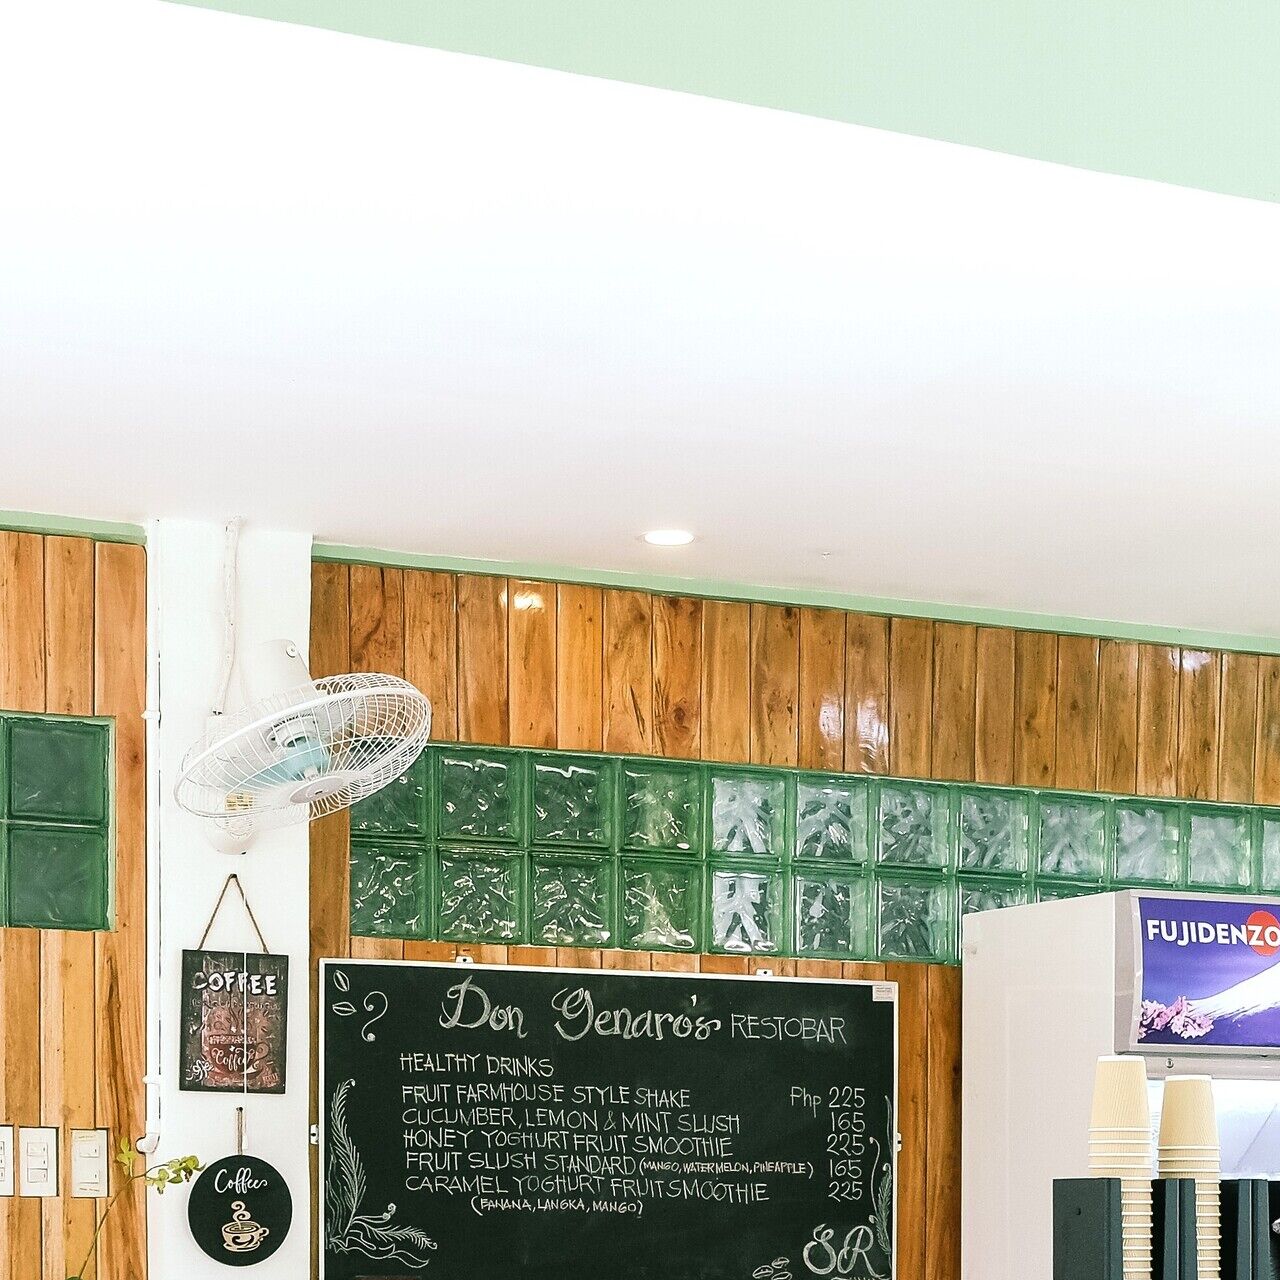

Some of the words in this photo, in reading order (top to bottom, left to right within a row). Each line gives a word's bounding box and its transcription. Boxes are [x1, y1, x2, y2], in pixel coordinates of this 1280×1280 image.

[192, 971, 277, 995] COFFEE
[438, 974, 529, 1039] Don
[730, 1012, 847, 1045] RESTOBAR
[399, 1052, 481, 1074] HEALTHY
[486, 1053, 555, 1078] DRINKS
[402, 1084, 451, 1104] FRUIT
[456, 1082, 564, 1104] FARMHOUSE
[571, 1085, 631, 1106] STYLE
[633, 1087, 691, 1109] SHAKE
[789, 1086, 822, 1118] Php
[828, 1086, 866, 1109] 225
[402, 1106, 523, 1130] CUCUMBER,
[525, 1107, 598, 1132] LEMON
[603, 1110, 617, 1131] &
[621, 1110, 672, 1135] MINT
[677, 1113, 740, 1135] SLUSH
[831, 1111, 866, 1133] 165
[403, 1126, 474, 1149] HONEY
[481, 1129, 570, 1150] YOGHURT
[573, 1133, 628, 1154] FRUIT
[631, 1135, 734, 1159] SMOOTHIE
[826, 1133, 866, 1156] 225
[406, 1151, 463, 1173] FRUIT
[467, 1151, 537, 1172] SLUSH
[543, 1155, 637, 1176] STANDARD
[829, 1159, 863, 1179] 165
[214, 1167, 268, 1195] Coffee
[405, 1174, 509, 1196] CARAMEL
[512, 1174, 605, 1196] YOGHURT
[610, 1177, 665, 1199] FRUIT
[666, 1178, 771, 1205] SMOOTHIE
[827, 1181, 864, 1203] 225
